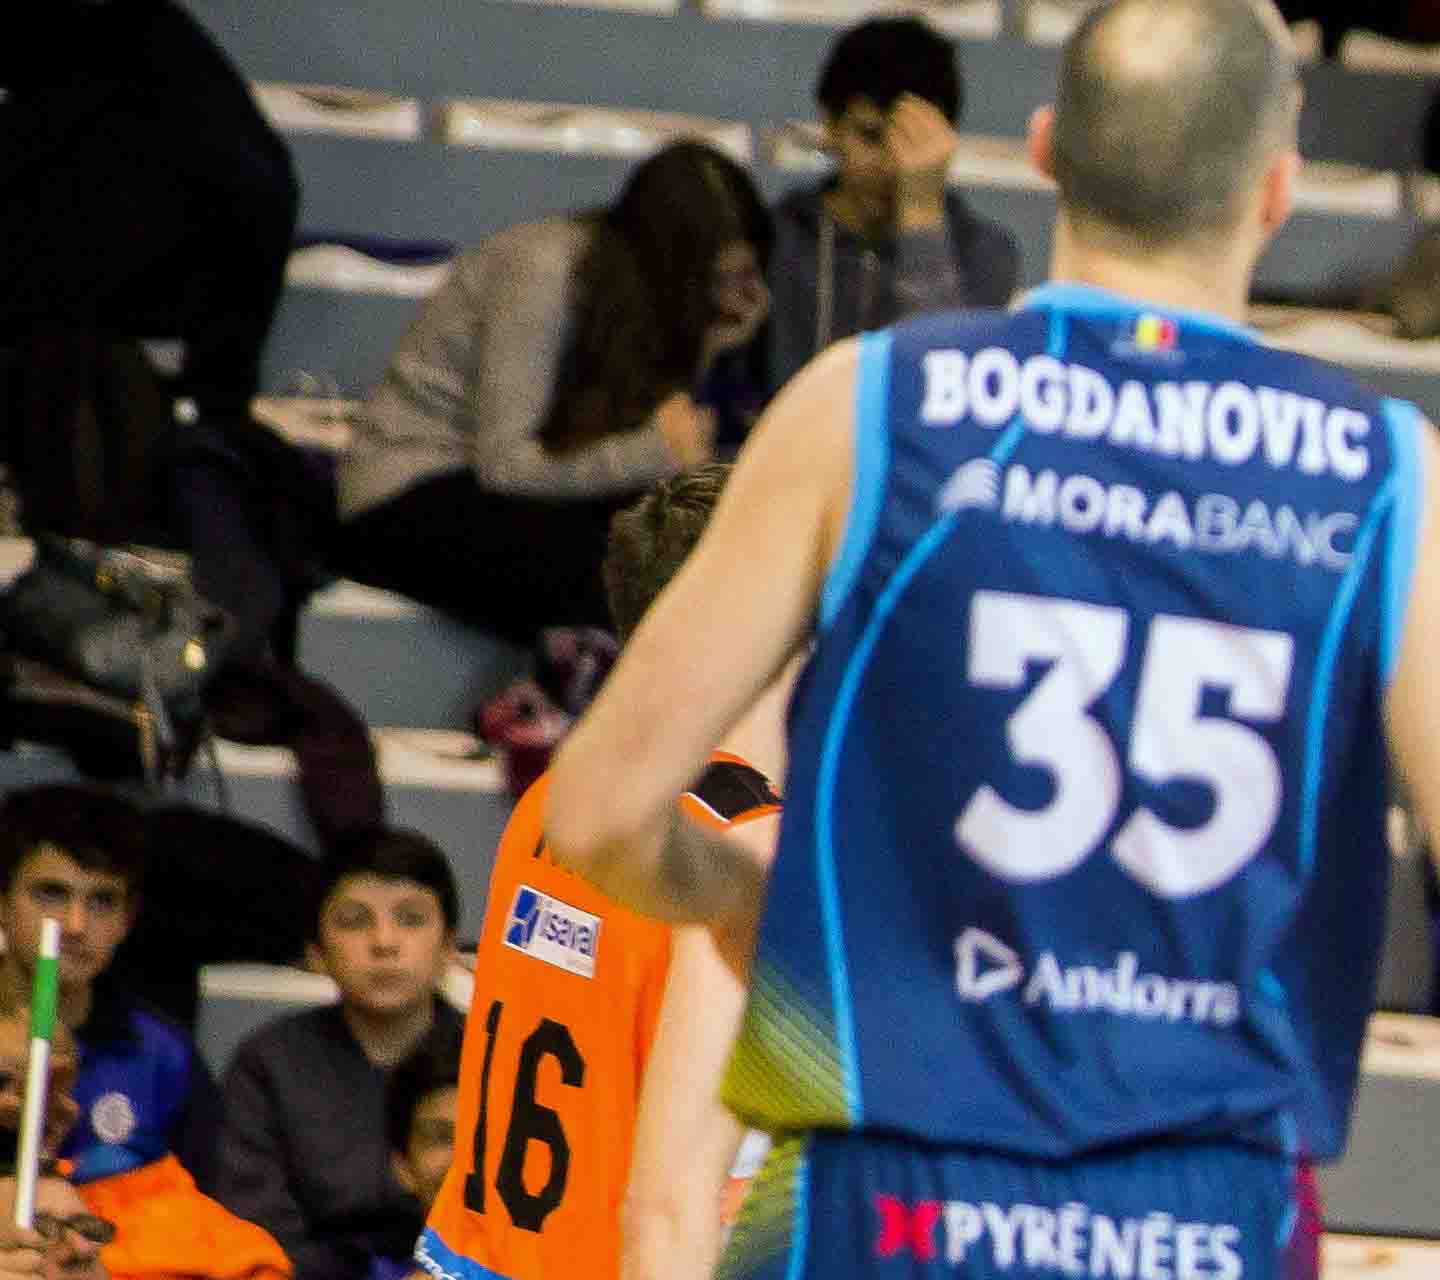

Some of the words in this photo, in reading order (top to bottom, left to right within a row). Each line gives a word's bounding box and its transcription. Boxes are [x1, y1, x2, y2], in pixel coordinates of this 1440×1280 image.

[921, 348, 1371, 480] BOGDANOVIC
[1004, 462, 1360, 570] MORABANC
[955, 588, 1296, 900] 35
[464, 999, 587, 1234] 16
